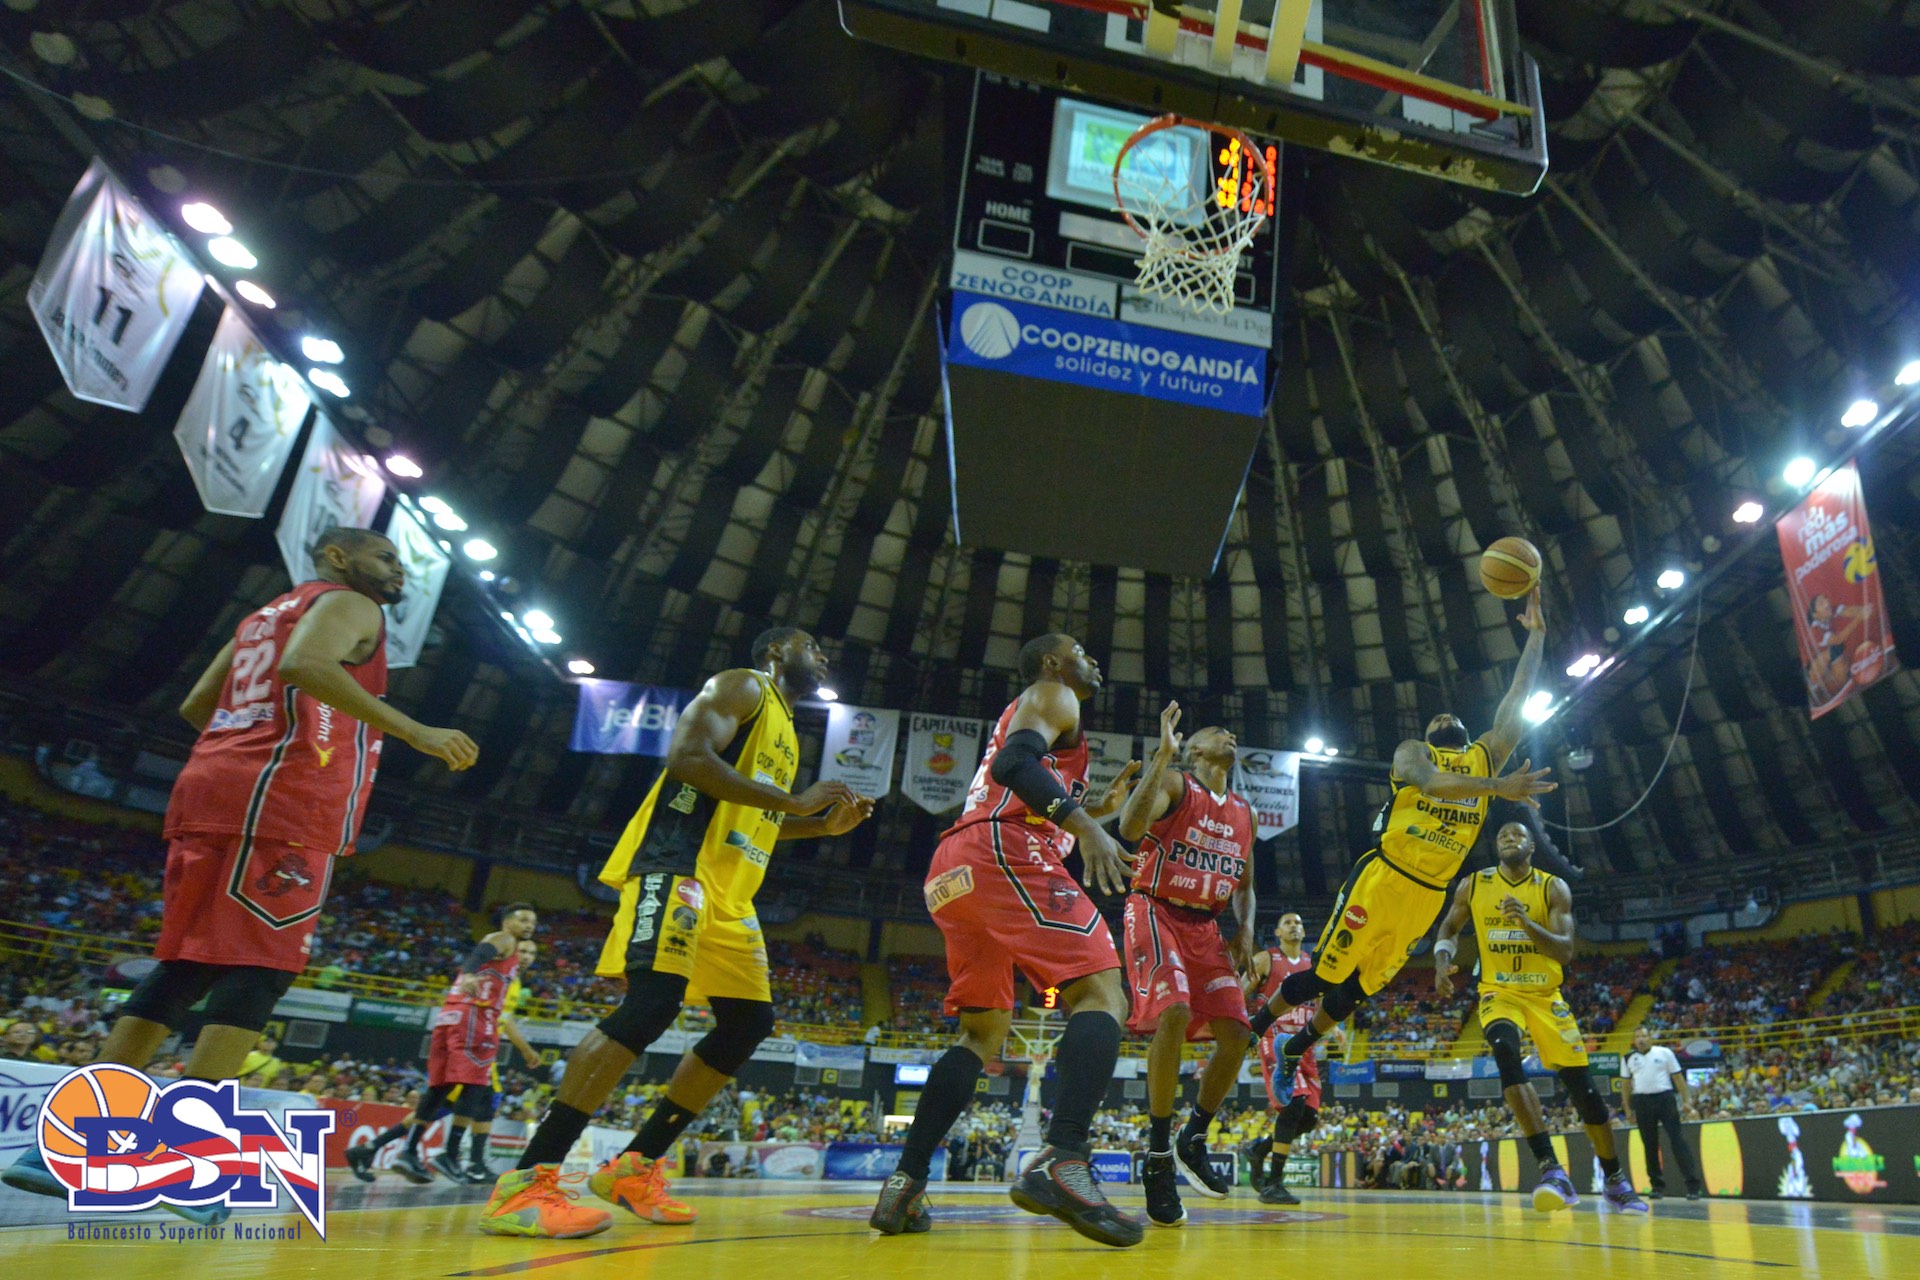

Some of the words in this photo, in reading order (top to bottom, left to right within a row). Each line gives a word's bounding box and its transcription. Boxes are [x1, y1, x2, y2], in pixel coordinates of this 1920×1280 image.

[985, 201, 1031, 225] HOME
[1001, 265, 1072, 290] COOP
[956, 272, 1112, 316] ZENOGANDÍA
[94, 285, 133, 345] 11
[1021, 323, 1259, 385] COOPZENOGANDÍA
[1055, 354, 1132, 382] solidez
[1140, 369, 1152, 385] y
[1159, 373, 1223, 398] futuro
[1794, 524, 1859, 585] poderosa
[232, 639, 275, 706] 22
[600, 700, 679, 732] jetBl
[912, 716, 978, 739] CAPITANES
[912, 775, 964, 787] CAMPEONES
[1236, 783, 1295, 796] CAMPEONES
[1198, 815, 1235, 838] Jeep
[1258, 811, 1284, 827] 011
[1168, 840, 1247, 881] PONCE
[1169, 875, 1198, 890] AVIS
[1199, 873, 1213, 900] 1
[1512, 955, 1523, 972] 0
[1044, 992, 1057, 1009] 3
[887, 1174, 906, 1189] 23
[1283, 1173, 1311, 1184] AUTO
